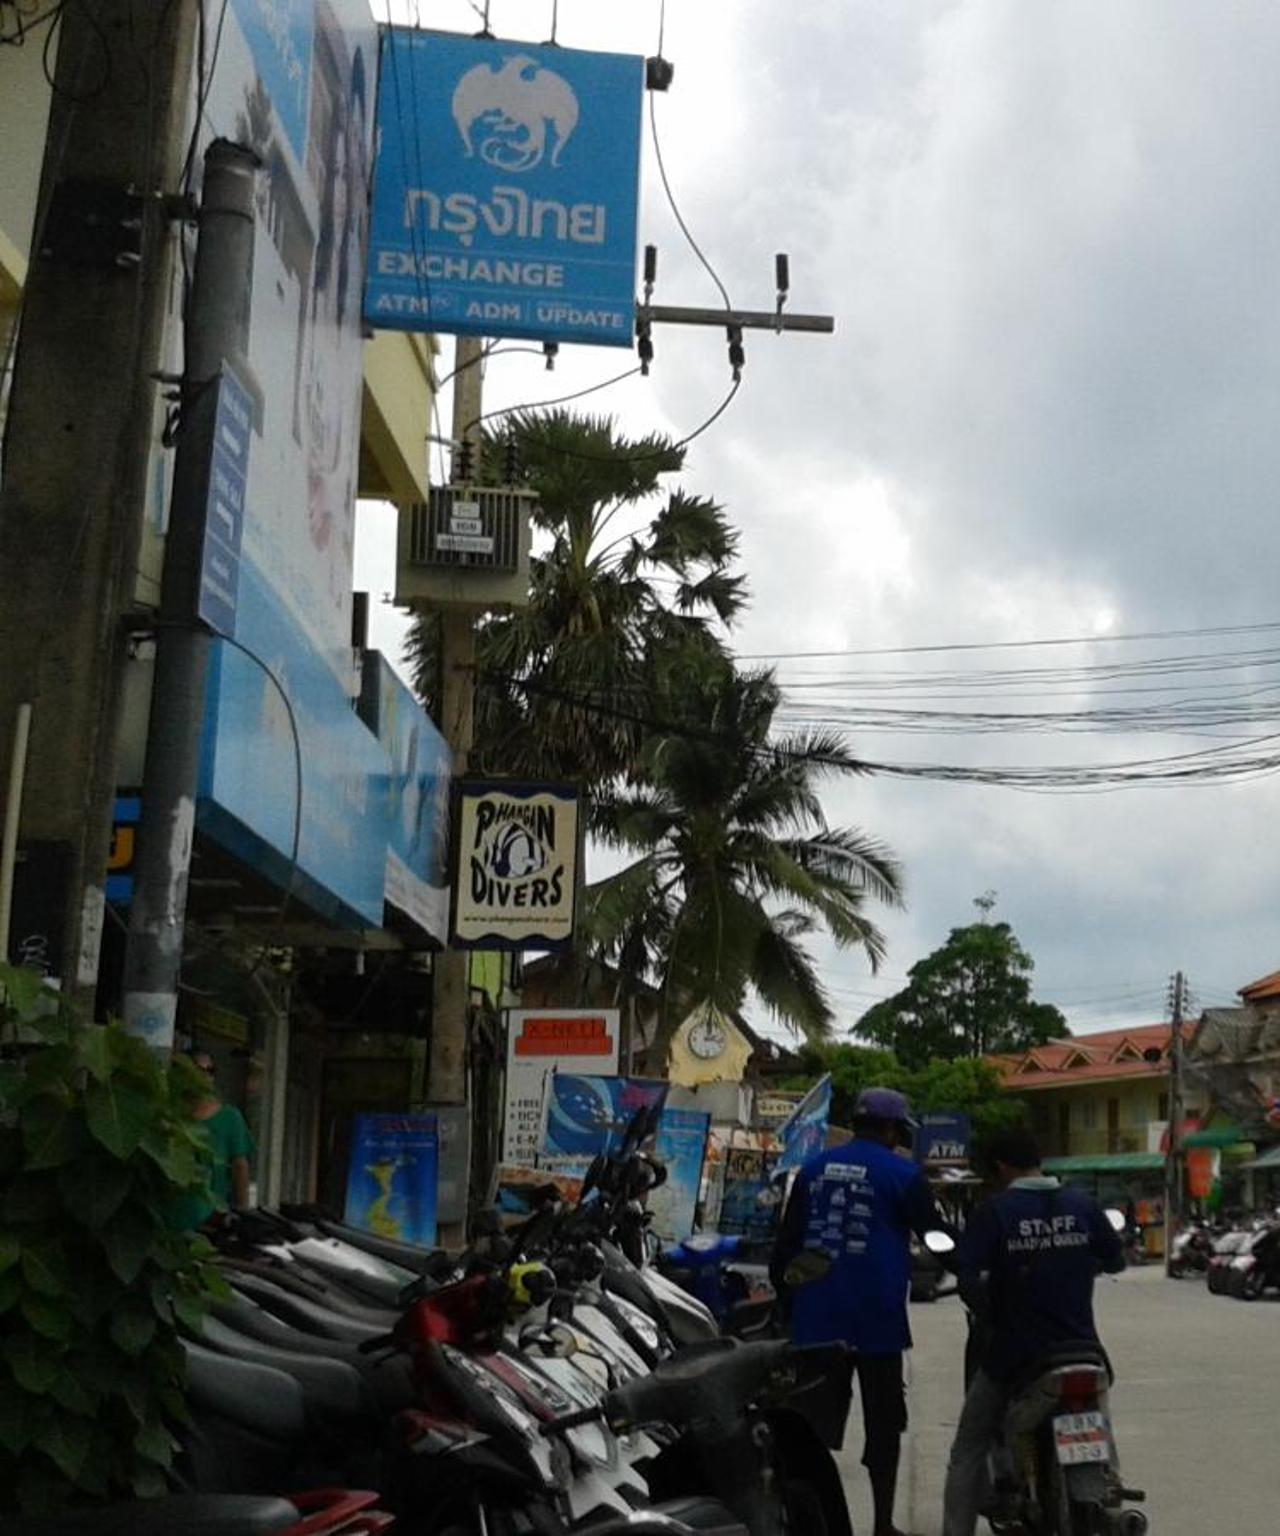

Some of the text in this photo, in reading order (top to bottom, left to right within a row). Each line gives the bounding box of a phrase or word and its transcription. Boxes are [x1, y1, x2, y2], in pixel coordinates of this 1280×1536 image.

[403, 186, 606, 247] กรุงไทย
[376, 250, 565, 288] EXCHANGE
[374, 292, 428, 315] ATM
[466, 301, 521, 320] ADM
[537, 308, 626, 329] UPDATE
[471, 855, 564, 907] DIVERS
[1020, 1215, 1076, 1236] STAFF
